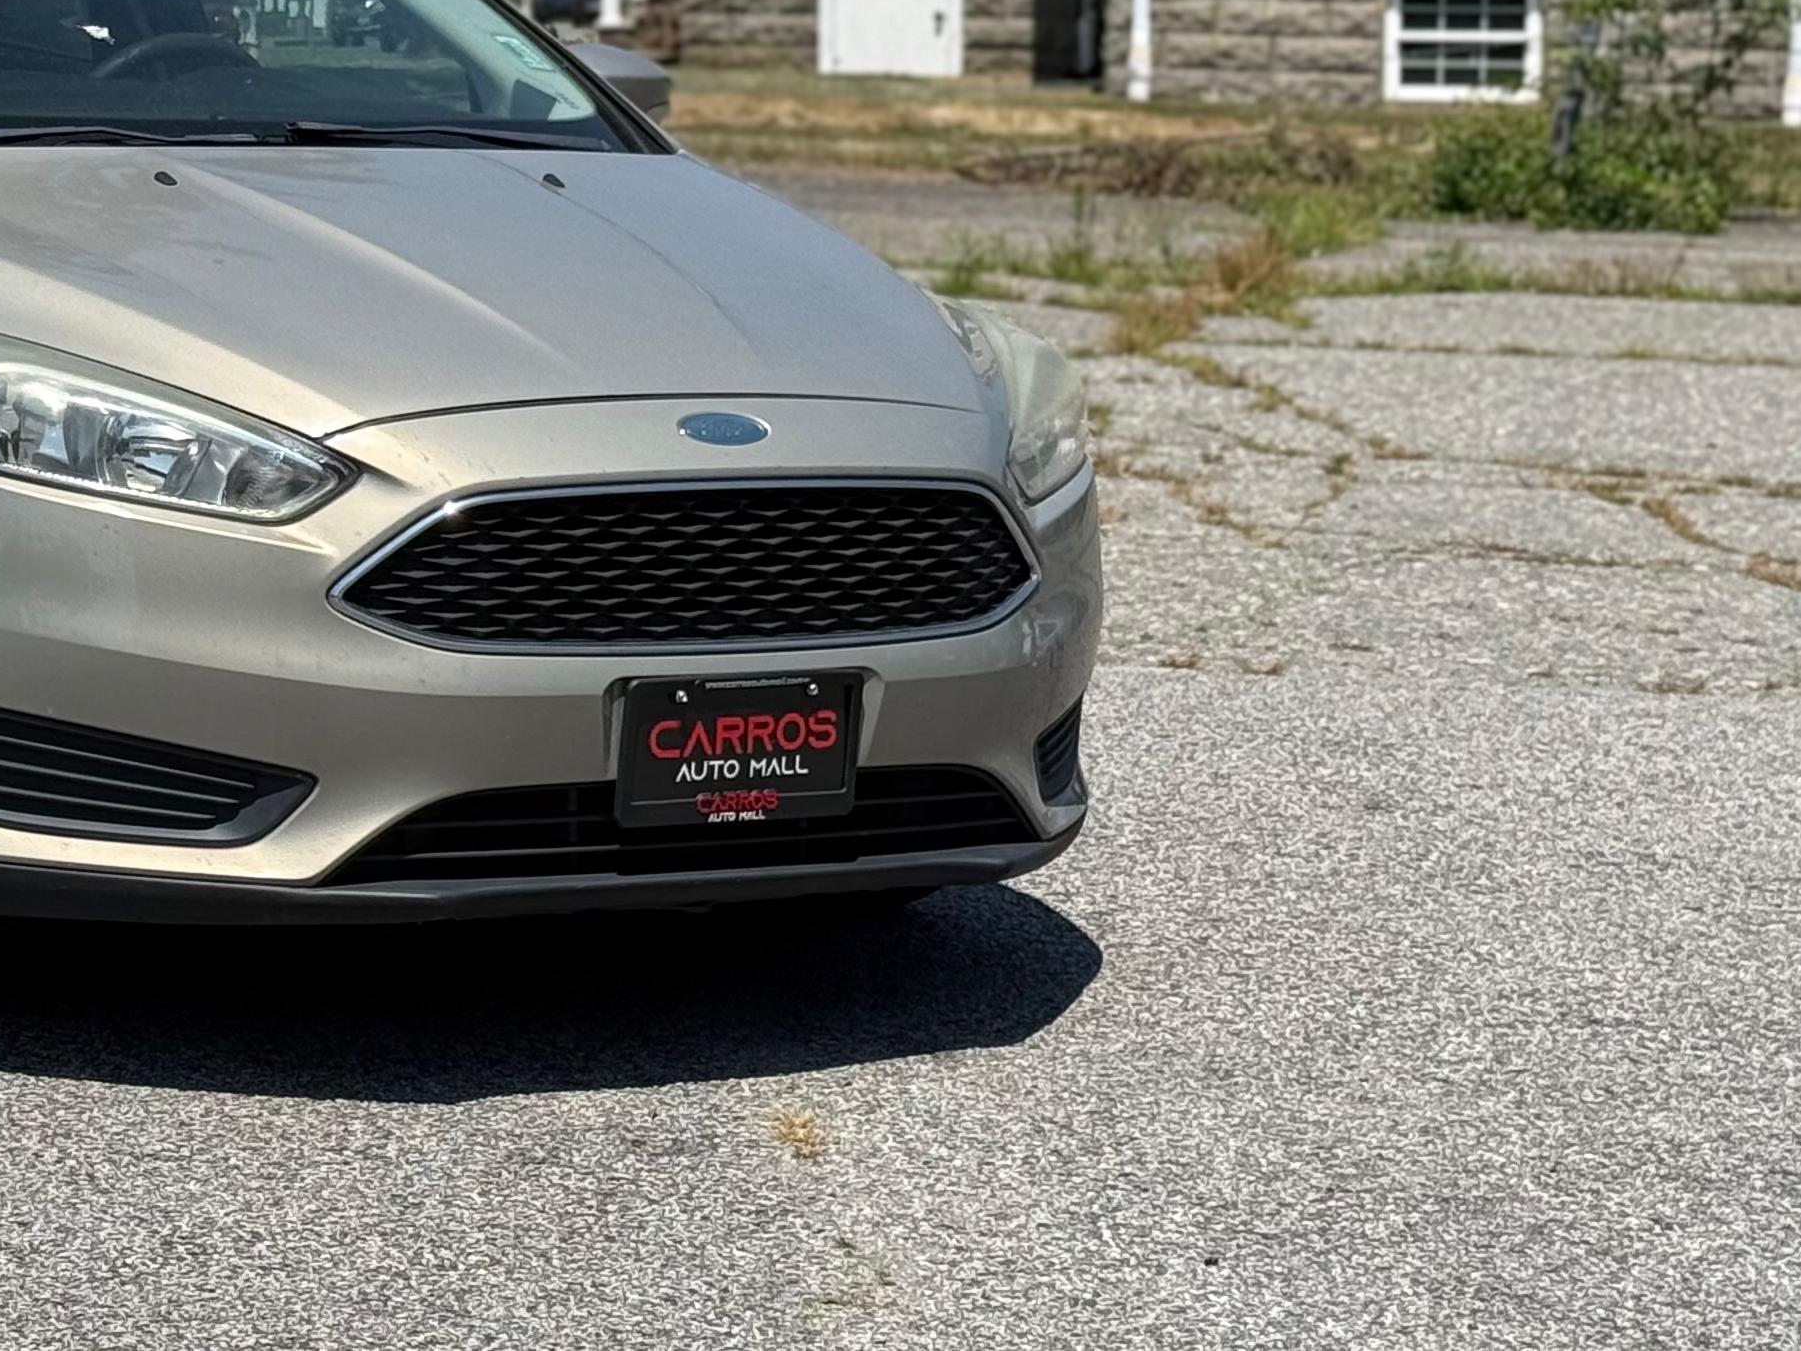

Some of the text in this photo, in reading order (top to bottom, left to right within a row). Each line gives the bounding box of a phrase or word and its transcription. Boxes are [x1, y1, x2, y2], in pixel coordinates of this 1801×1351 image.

[649, 709, 837, 758] CARROS
[675, 755, 809, 783] AUTO MALL
[695, 789, 780, 814] CARROS
